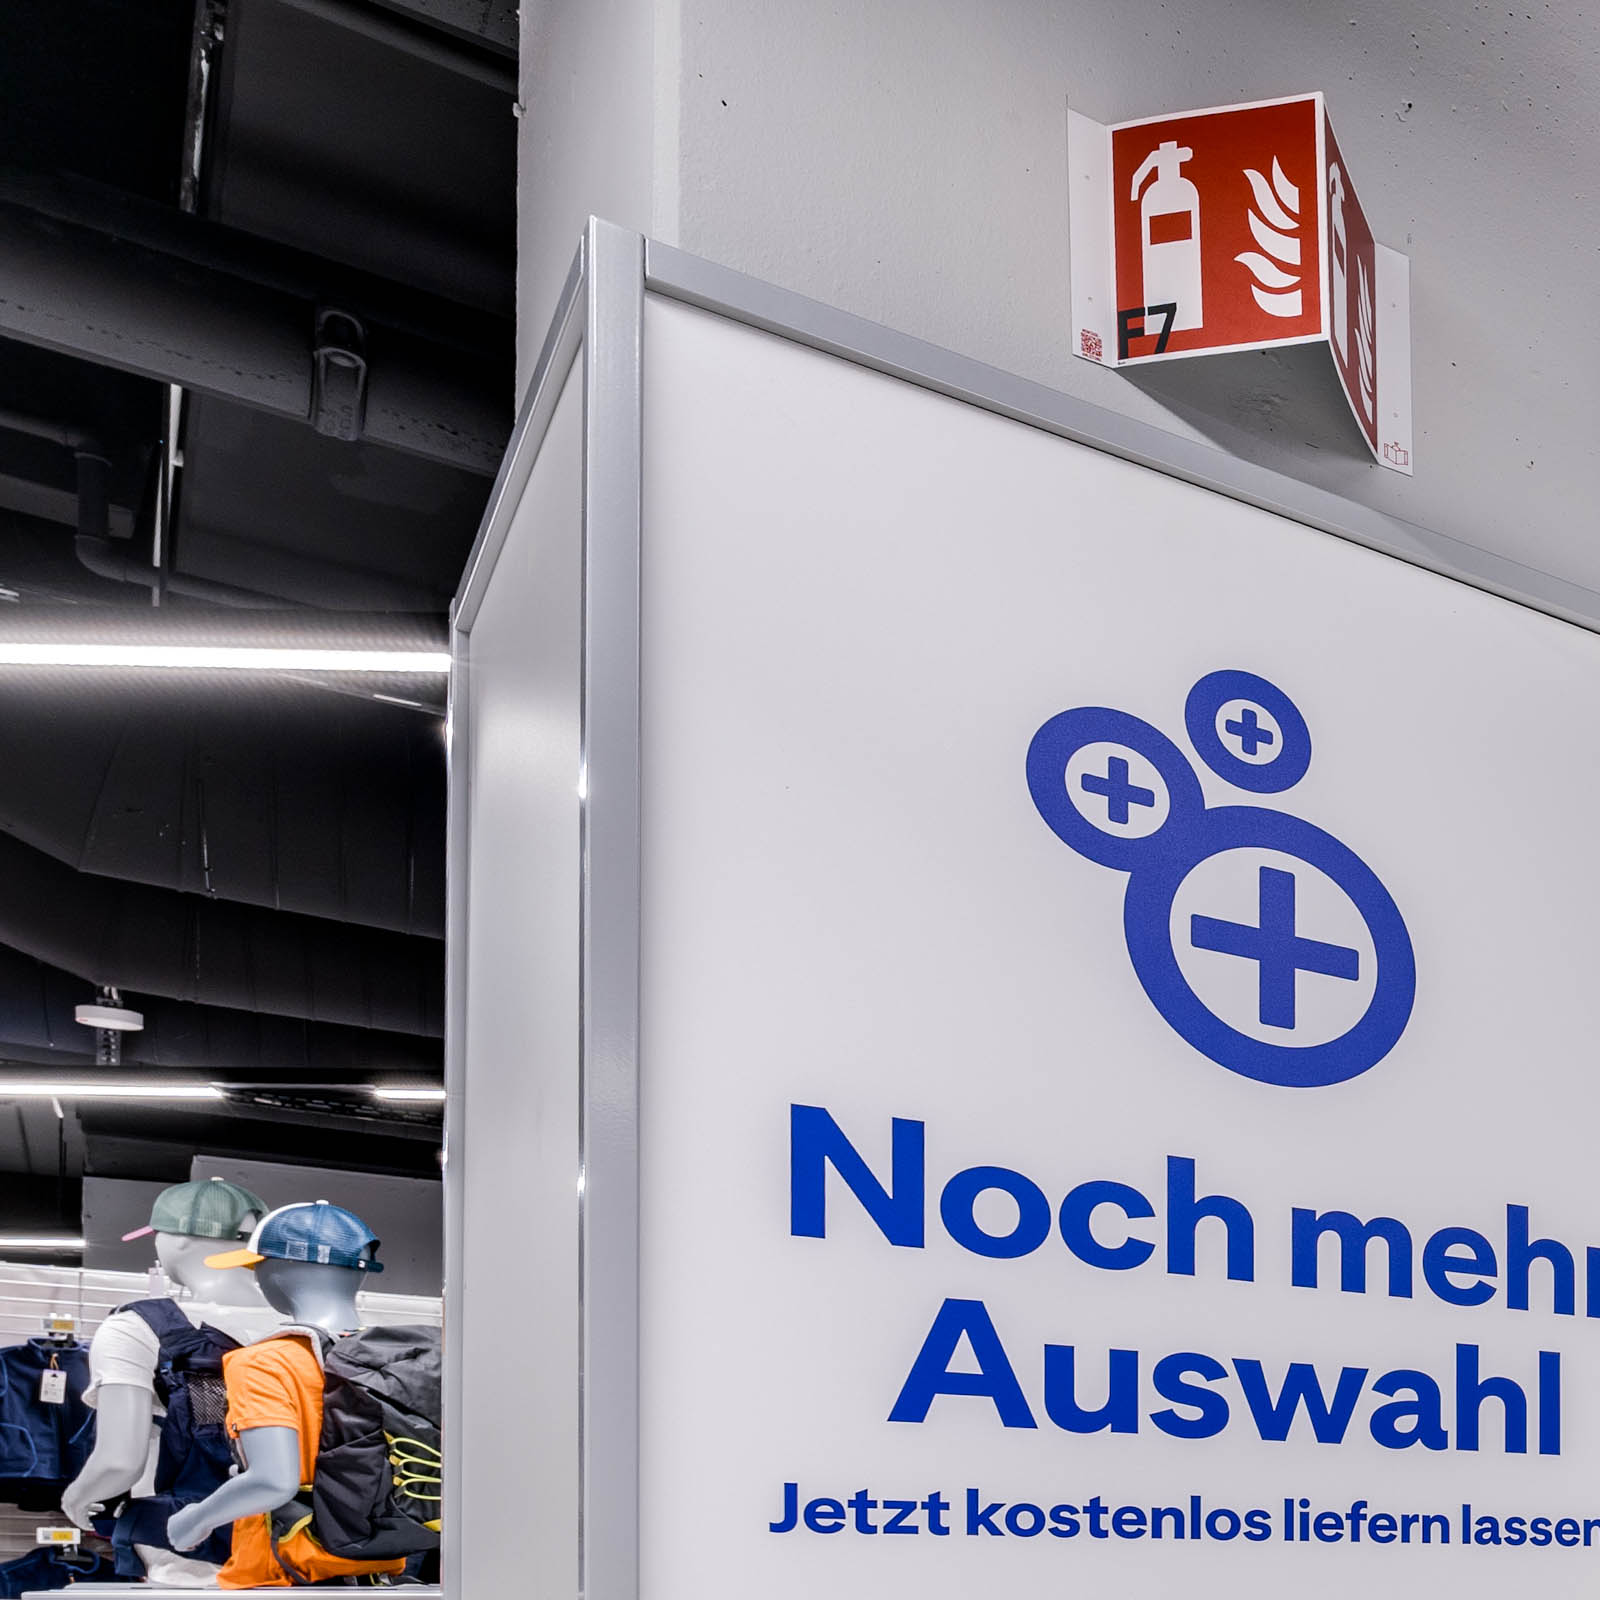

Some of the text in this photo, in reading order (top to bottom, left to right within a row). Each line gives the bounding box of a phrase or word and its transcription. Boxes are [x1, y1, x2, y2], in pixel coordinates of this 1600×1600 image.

[1117, 302, 1177, 359] F7
[791, 1104, 1254, 1282] Noch
[887, 1298, 1560, 1455] Auswahl
[769, 1483, 950, 1536] Jetzt
[967, 1488, 1271, 1541] kostenlos
[1284, 1498, 1450, 1544] liefern
